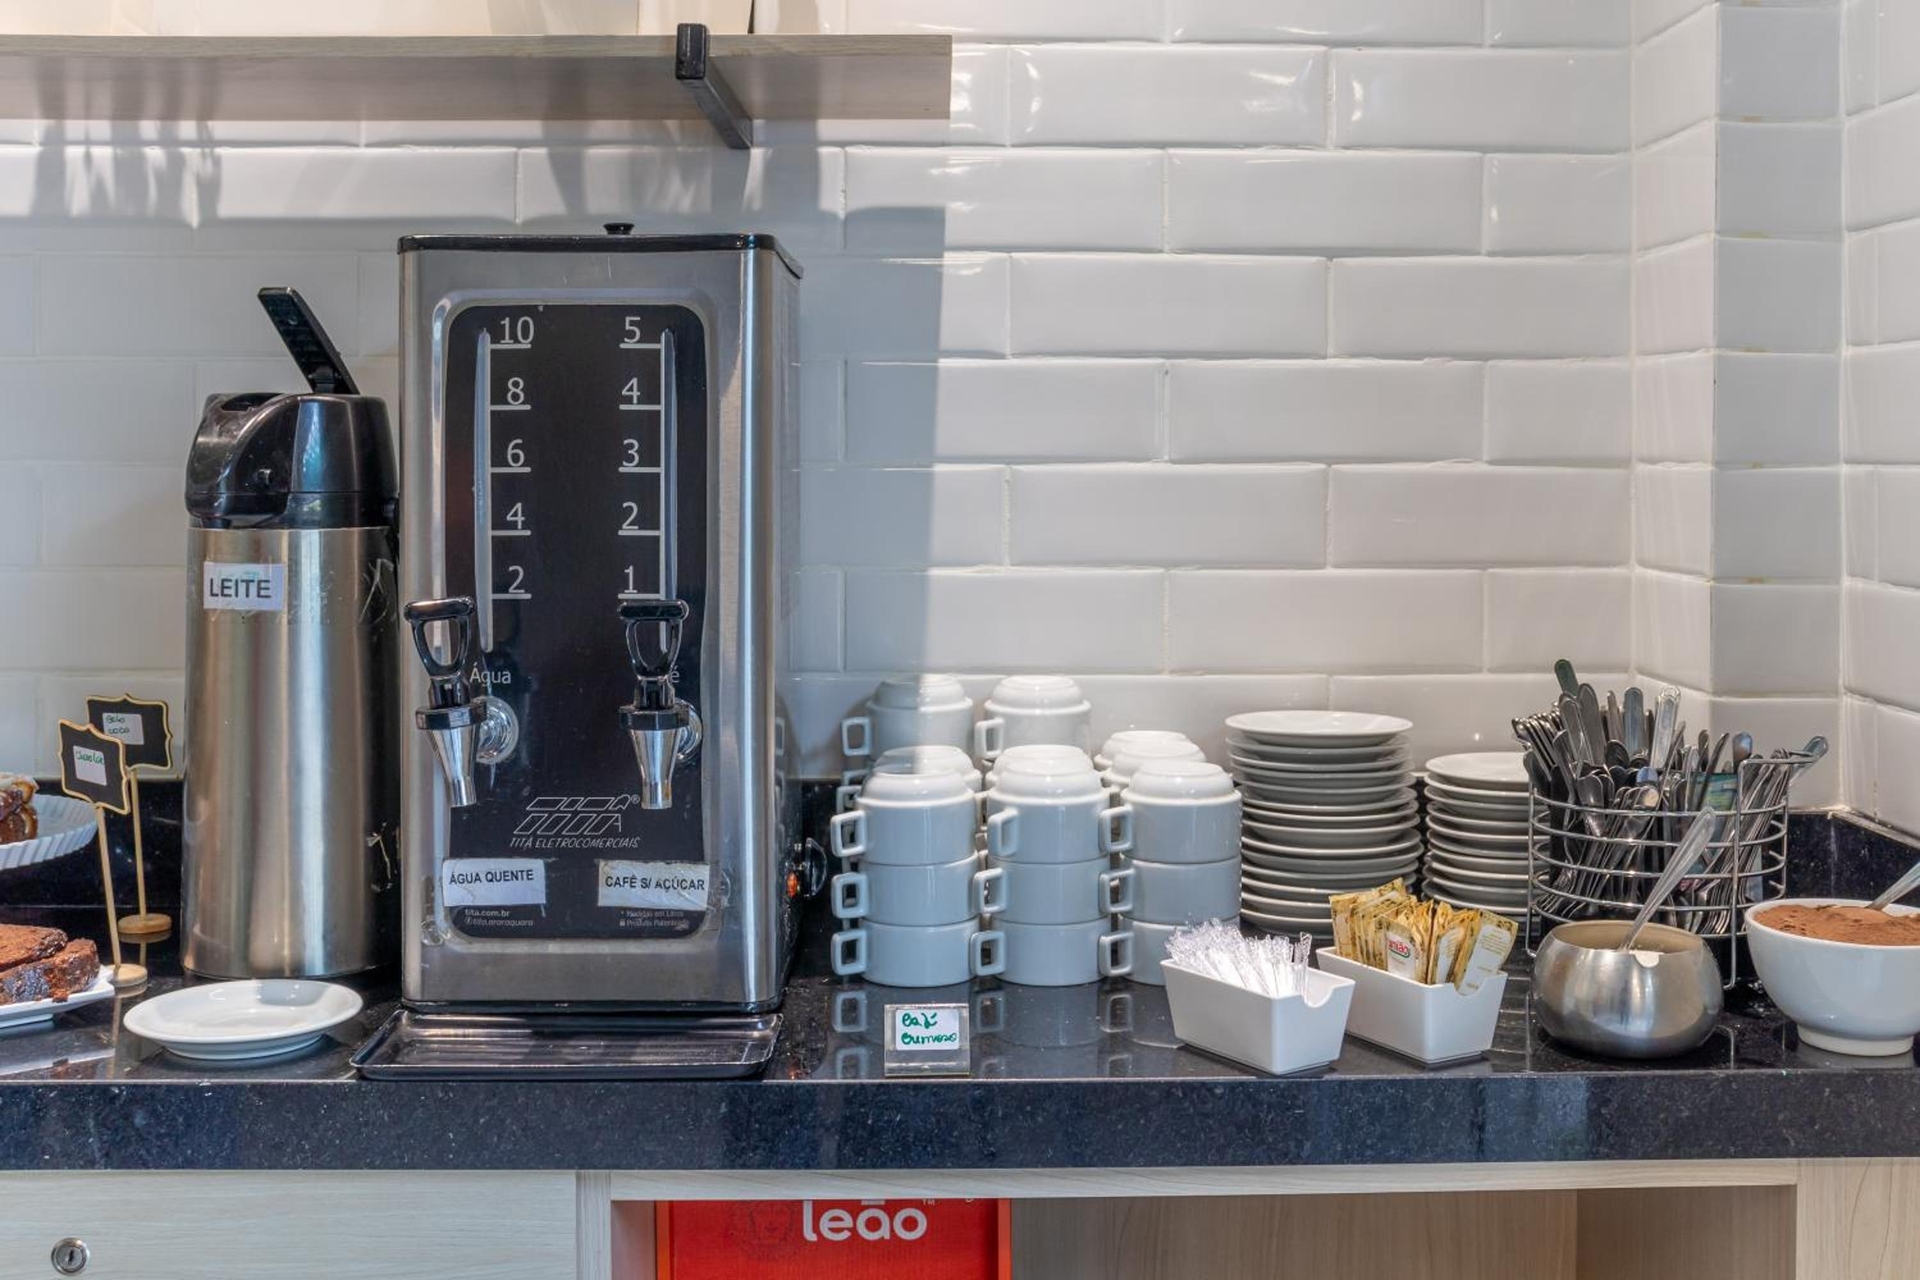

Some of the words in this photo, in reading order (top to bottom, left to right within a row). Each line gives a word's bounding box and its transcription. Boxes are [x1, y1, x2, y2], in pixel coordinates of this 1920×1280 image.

[500, 317, 534, 343] 10
[624, 316, 641, 343] 5
[507, 377, 525, 404] 8
[622, 377, 641, 404] 4
[507, 439, 525, 467] 6
[622, 439, 639, 467] 3
[506, 502, 525, 529] 4
[622, 502, 639, 529] 2
[209, 577, 272, 599] LEITE
[508, 566, 525, 593] 2
[624, 566, 637, 593] 1
[469, 662, 512, 686] Água
[449, 871, 482, 885] ÁGUA
[485, 869, 534, 882] QUENTE
[605, 873, 637, 889] CAFÉ
[655, 876, 705, 892] AÇÚCAR
